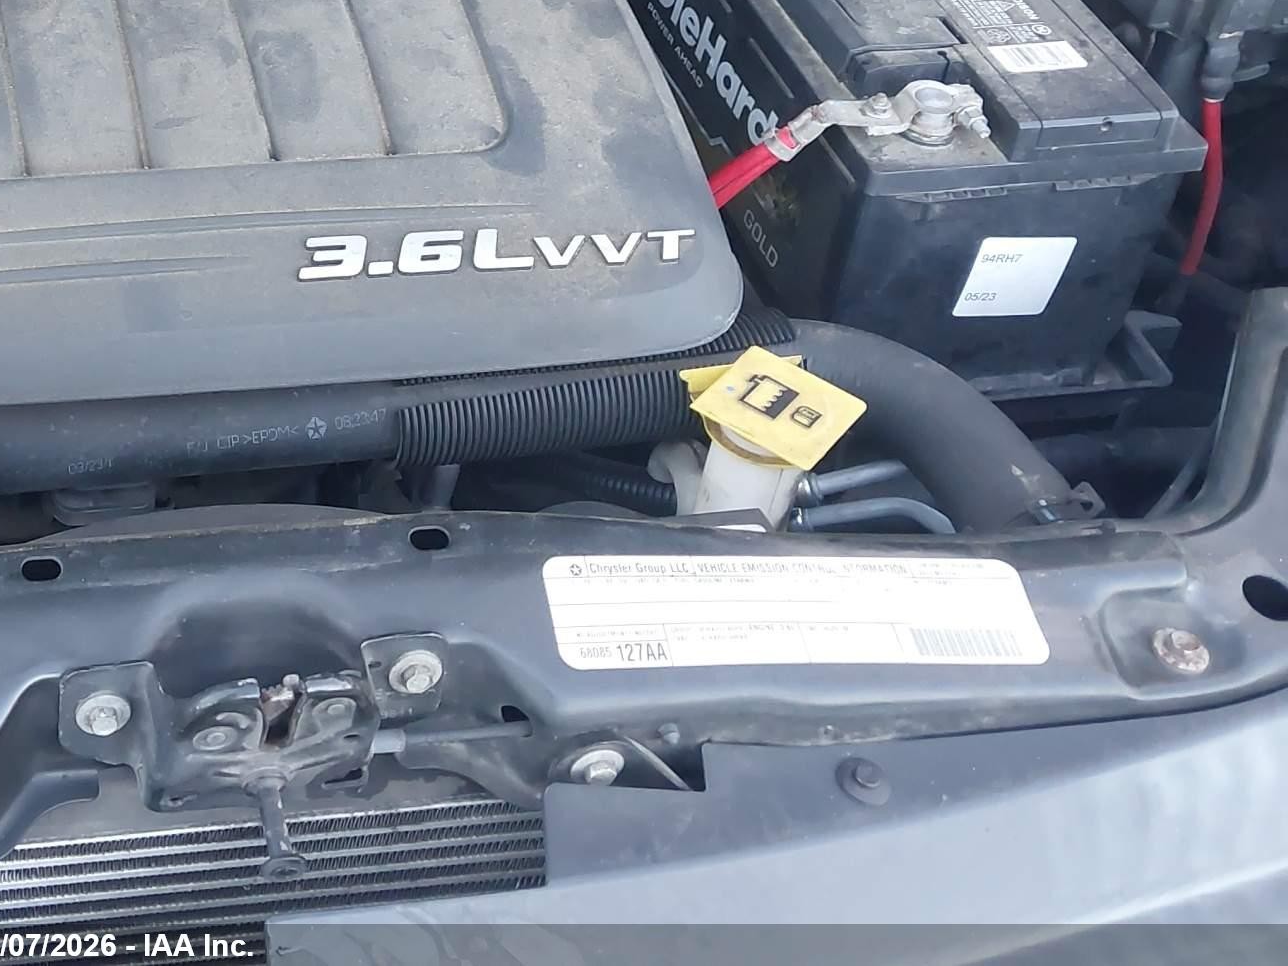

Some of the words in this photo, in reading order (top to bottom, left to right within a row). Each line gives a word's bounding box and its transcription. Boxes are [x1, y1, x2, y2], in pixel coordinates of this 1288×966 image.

[648, 2, 674, 44] POWER
[674, 45, 703, 88] AHEAD
[744, 209, 778, 267] GOLD
[980, 253, 1023, 264] 94RH7
[964, 292, 997, 302] 05/23
[589, 562, 631, 575] Chrysler
[635, 562, 666, 575] Group
[670, 562, 689, 573] LLC
[697, 562, 737, 574] VEHICLE
[742, 562, 789, 574] EMISSION
[840, 562, 909, 575] NFORMATION
[616, 643, 668, 662] 127AA
